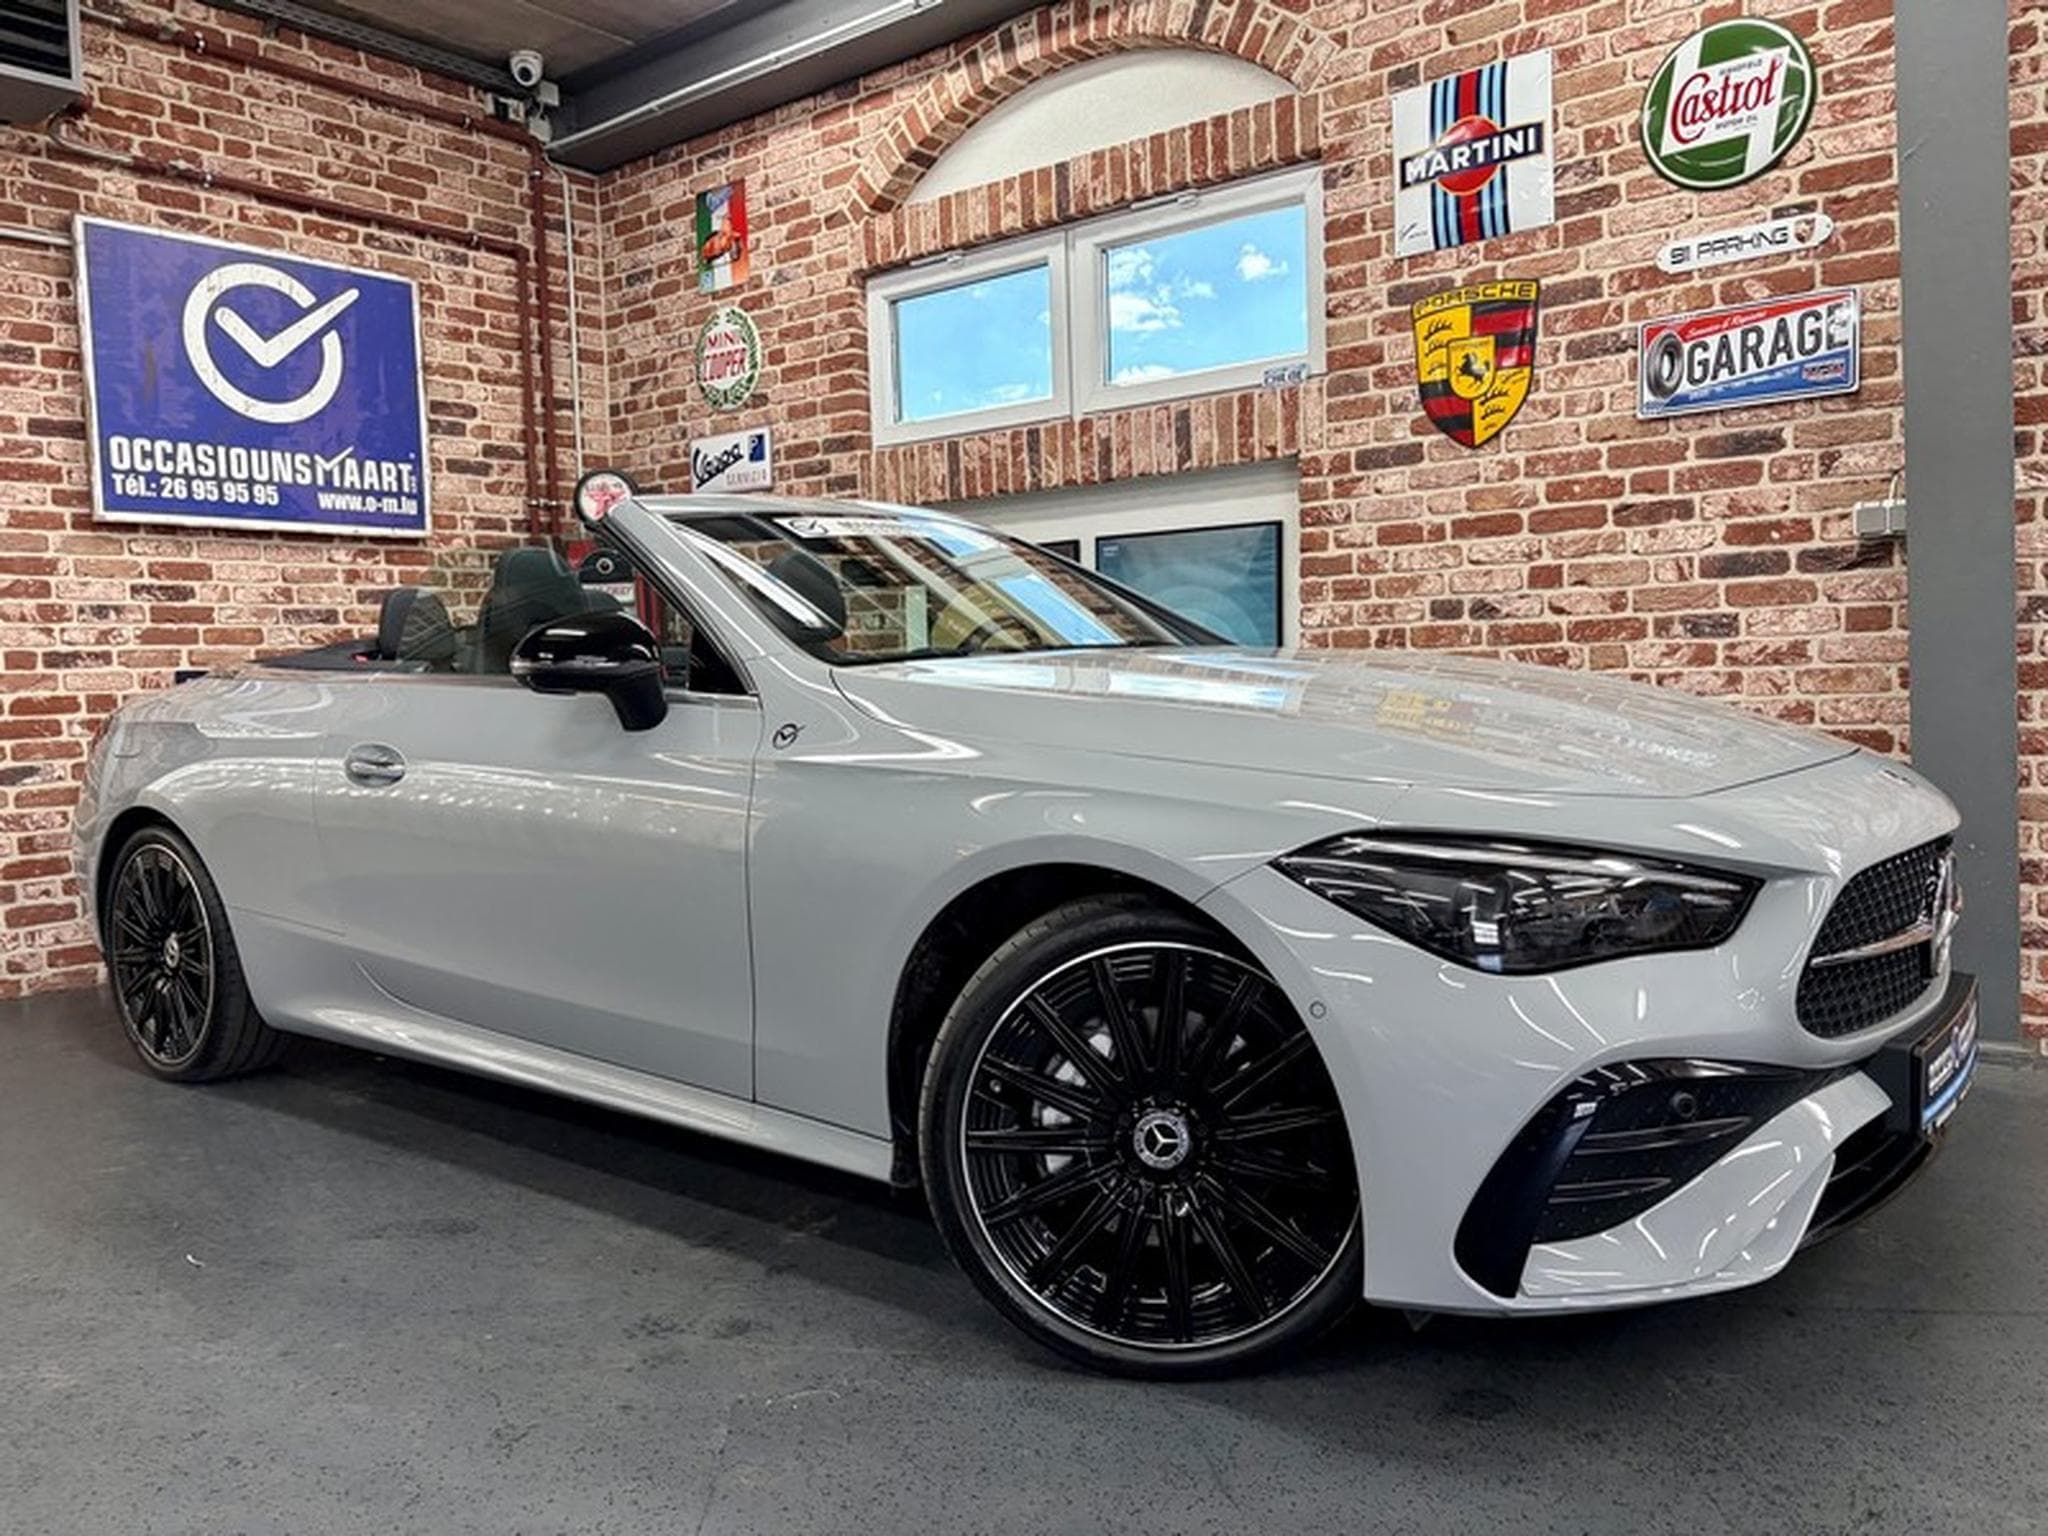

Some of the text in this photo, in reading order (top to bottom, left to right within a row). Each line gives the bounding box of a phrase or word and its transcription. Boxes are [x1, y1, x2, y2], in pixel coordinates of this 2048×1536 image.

[1671, 55, 1783, 144] Castrol
[1405, 127, 1536, 184] MARTINI
[1697, 226, 1789, 259] PARKING
[1414, 283, 1534, 316] PORSCHE
[1686, 302, 1850, 387] GARAGE
[160, 476, 188, 499] 26
[191, 479, 219, 502] 95
[222, 481, 250, 504] 95
[252, 483, 279, 506] 95
